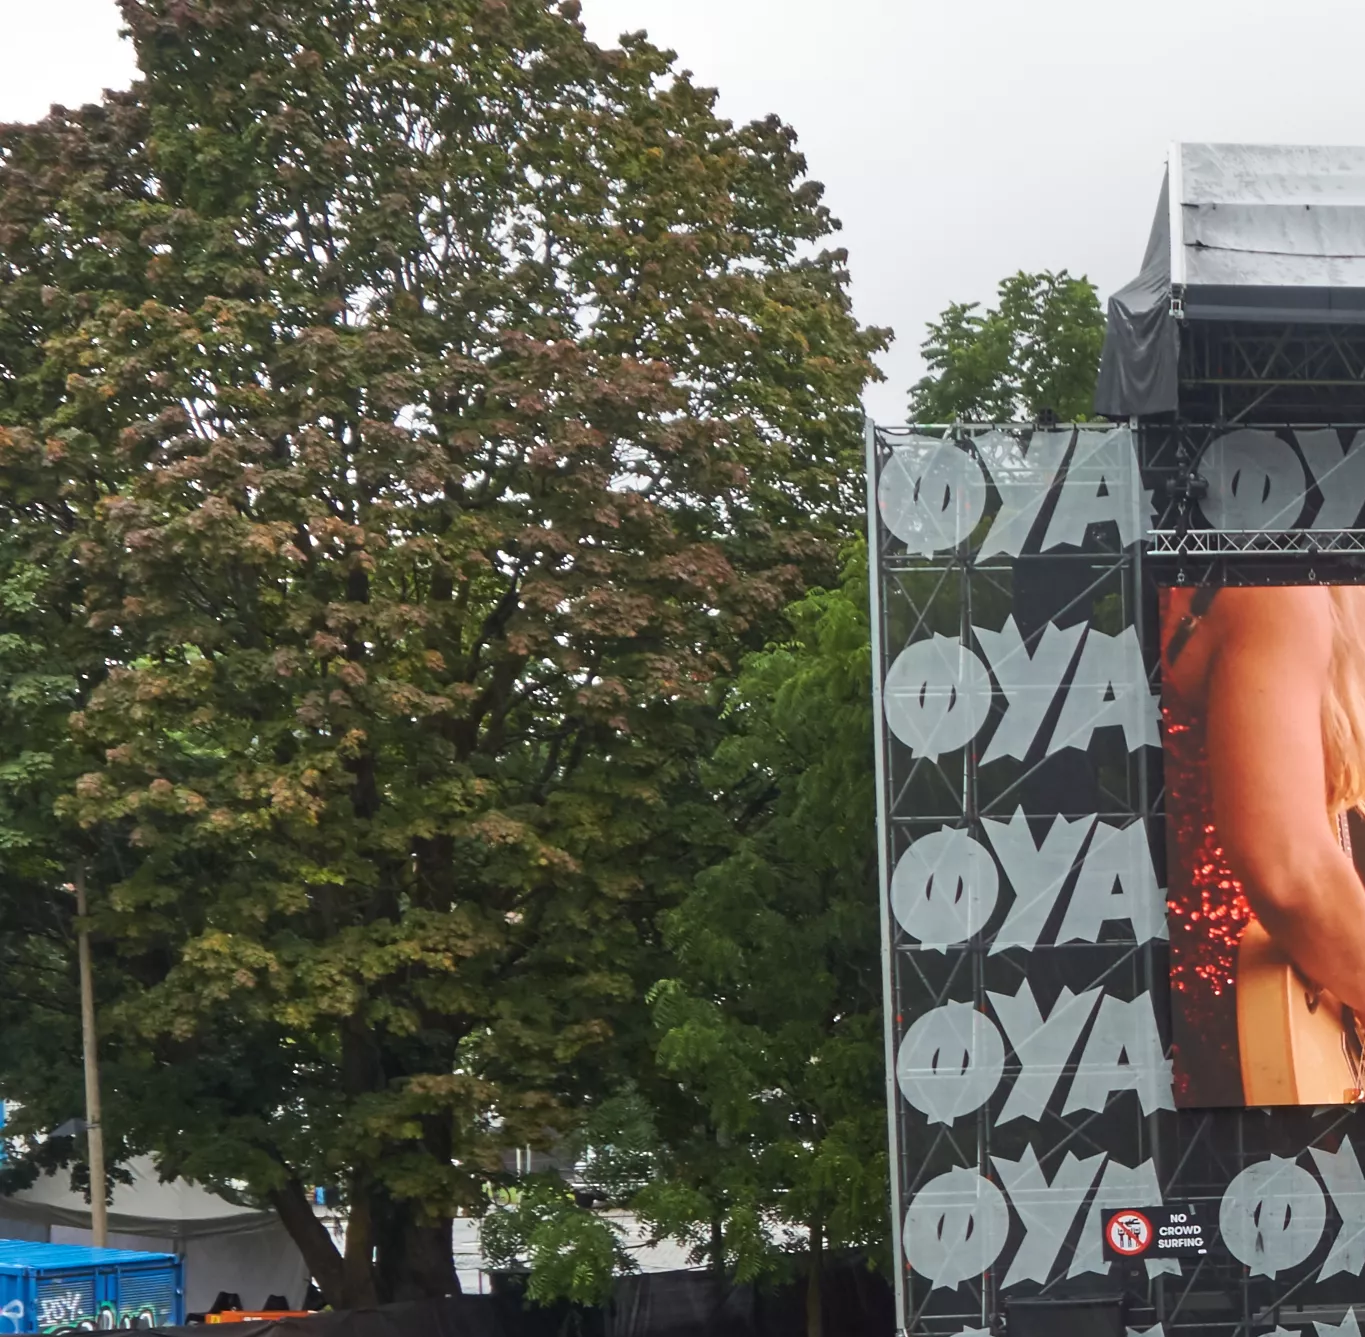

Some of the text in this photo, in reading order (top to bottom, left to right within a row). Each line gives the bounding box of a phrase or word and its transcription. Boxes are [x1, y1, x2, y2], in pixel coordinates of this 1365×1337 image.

[1170, 1213, 1187, 1222] NO
[1159, 1225, 1202, 1236] CROWD
[1158, 1237, 1204, 1248] SURFING
